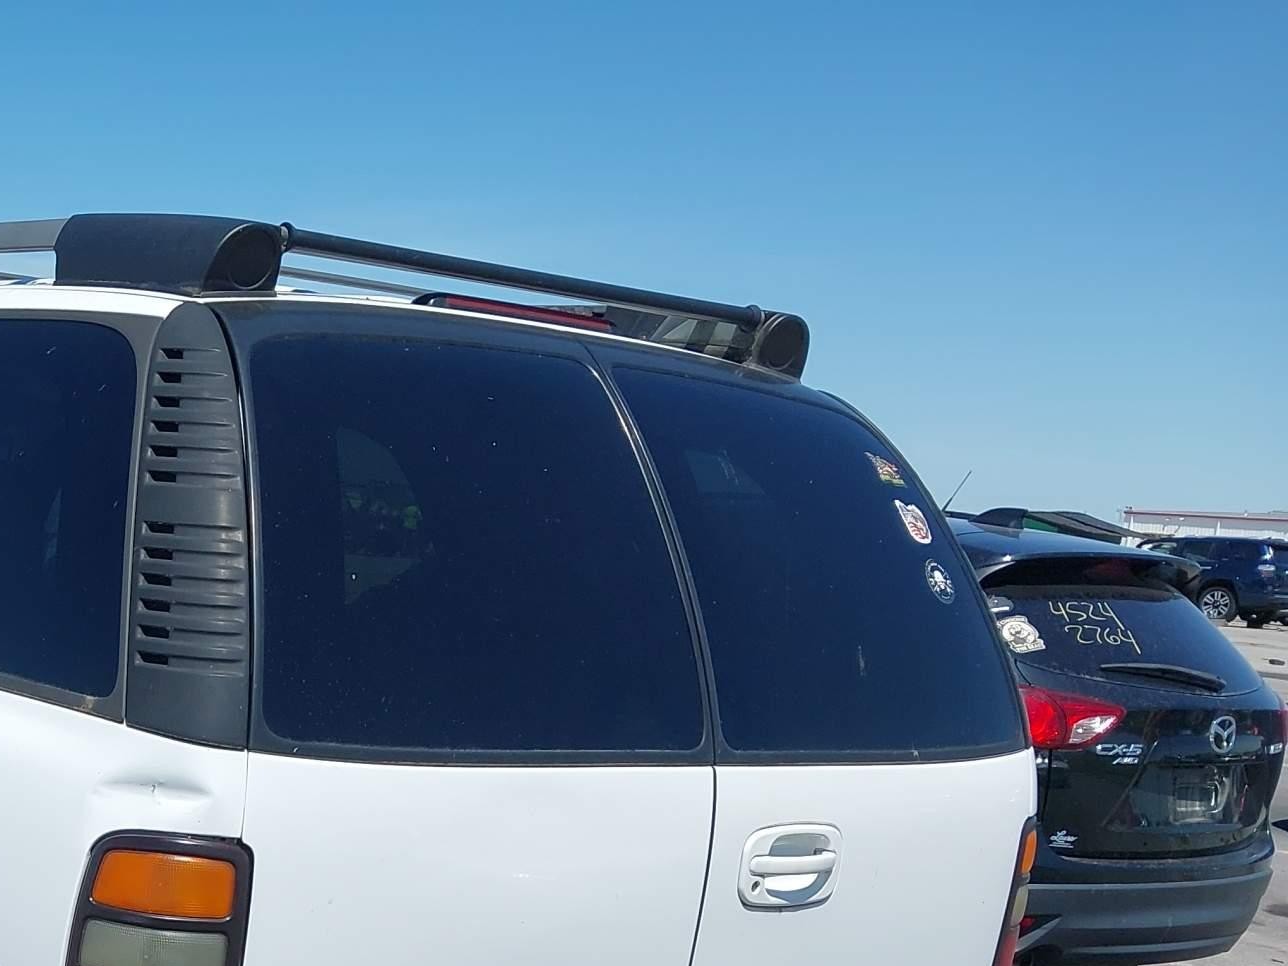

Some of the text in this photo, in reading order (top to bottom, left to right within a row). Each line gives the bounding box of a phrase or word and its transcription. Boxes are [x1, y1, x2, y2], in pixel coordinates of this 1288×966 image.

[1048, 601, 1125, 631] 4524
[1064, 624, 1141, 655] 2764
[1096, 743, 1143, 755] CX-5
